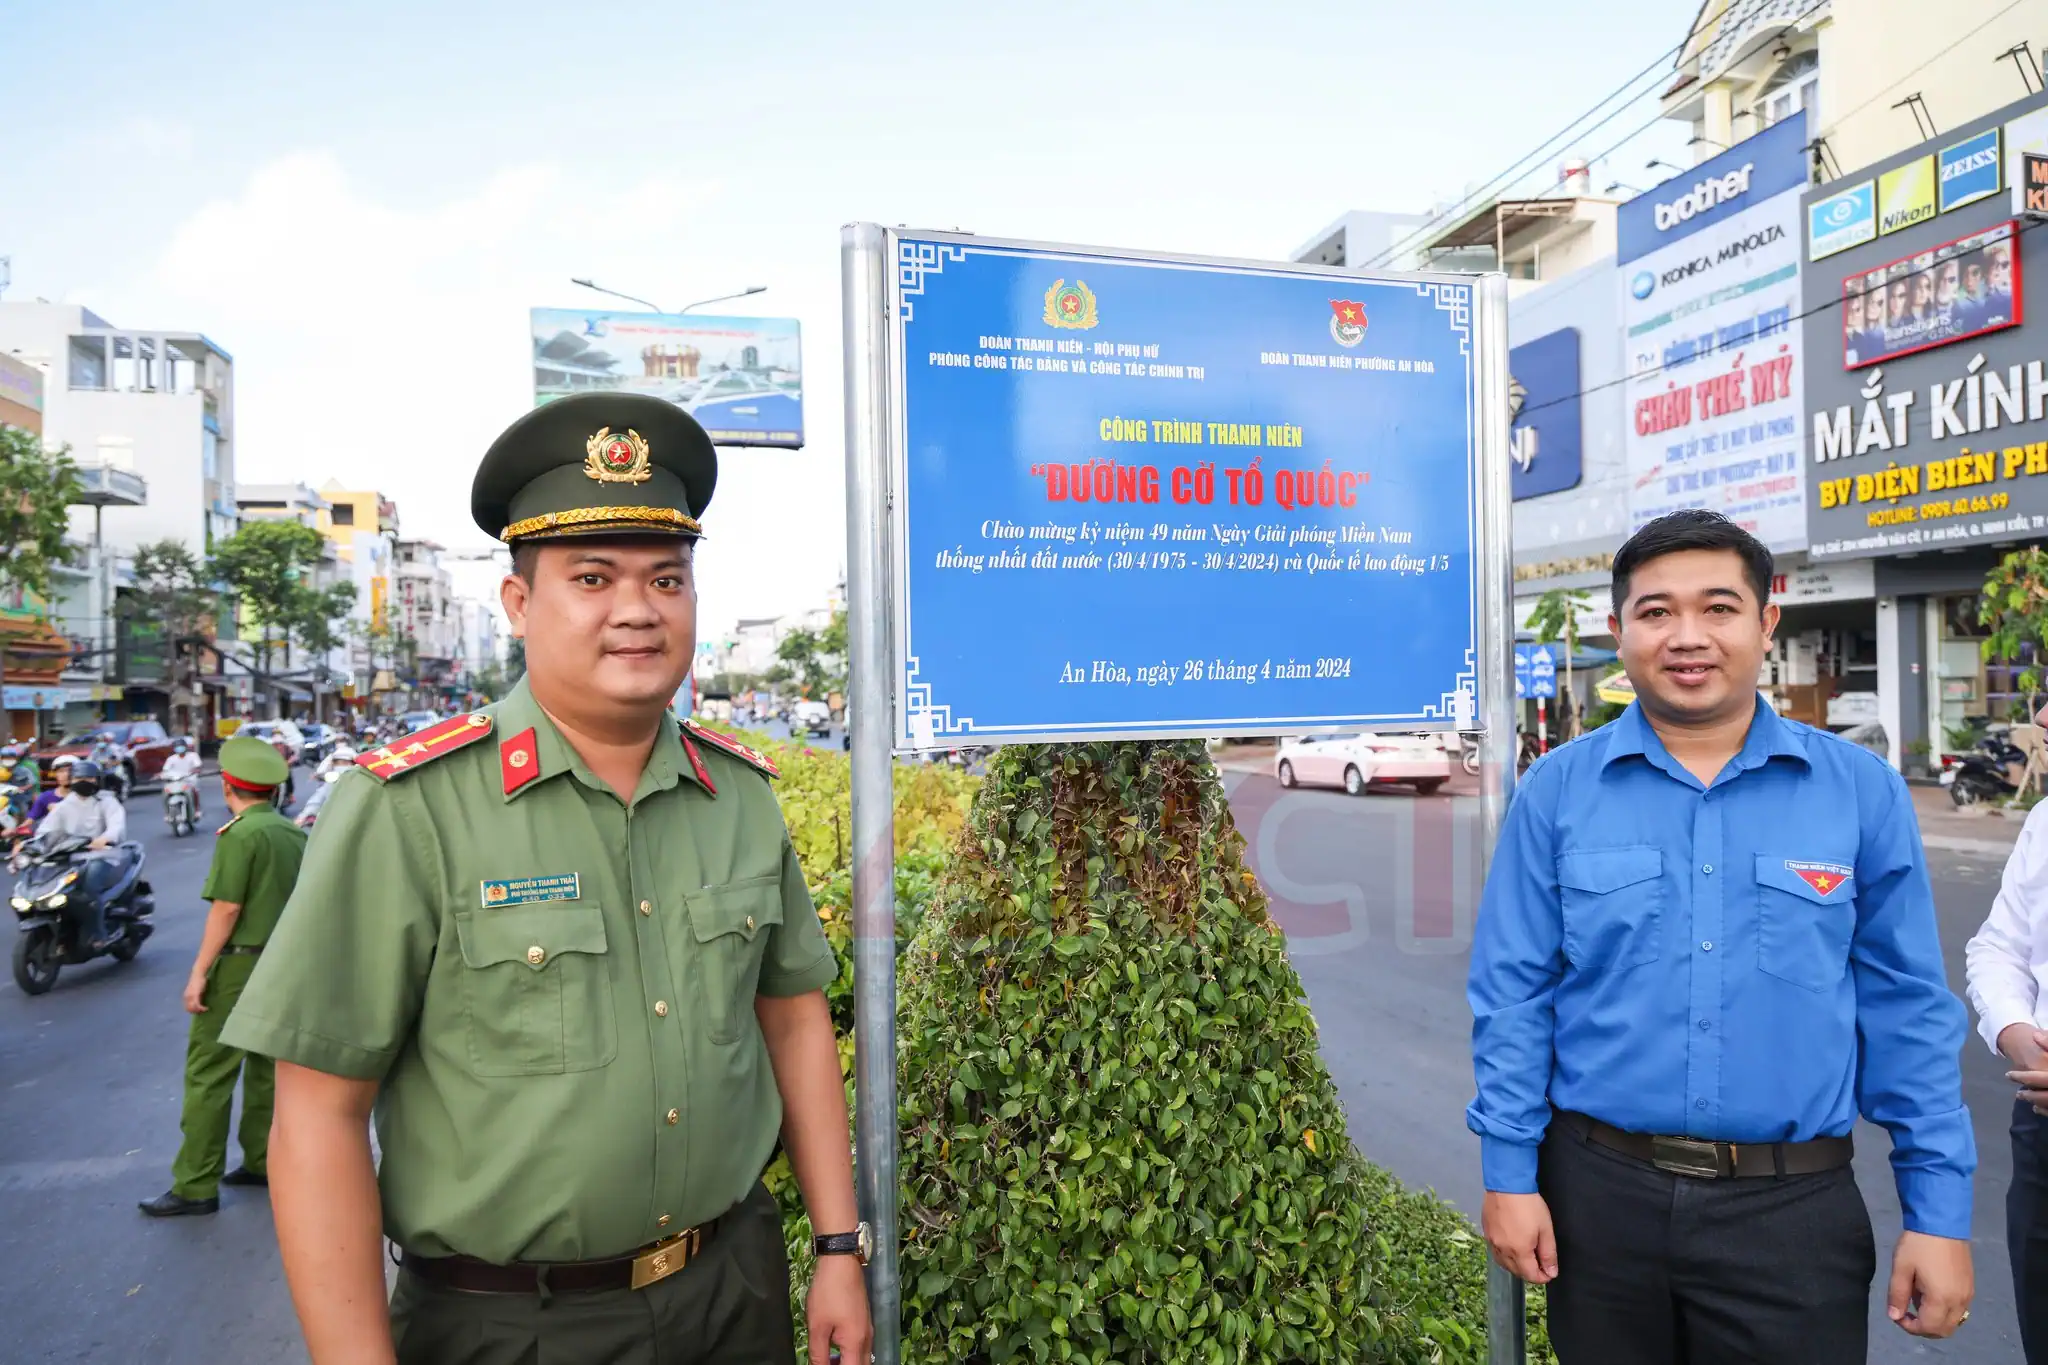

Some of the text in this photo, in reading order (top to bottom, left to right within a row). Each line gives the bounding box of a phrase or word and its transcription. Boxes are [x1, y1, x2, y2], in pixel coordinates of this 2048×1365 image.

[1941, 145, 1998, 182] ZEISS
[1654, 162, 1754, 231] brother
[1882, 203, 1932, 232] Nikon
[1661, 256, 1713, 288] KONICA
[1717, 224, 1786, 264] MINOLTA
[980, 334, 1012, 350] ĐOÀN
[1014, 337, 1054, 353] THANH
[1057, 338, 1083, 354] NIÊN
[1094, 340, 1114, 357] HỘI
[1117, 344, 1140, 360] PHỤ
[1143, 343, 1160, 359] NỮ
[1260, 350, 1435, 374] ĐOÀN THANH NIÊN PHƯỜNG AN HÒA
[929, 352, 970, 368] PHÒNG
[974, 354, 1007, 370] CÔNG
[1010, 355, 1033, 371] TÁC
[1071, 358, 1087, 374] VÀ
[1089, 360, 1121, 376] CÔNG
[1124, 362, 1146, 377] TÁC
[1149, 363, 1184, 379] CHÍNH
[1186, 366, 1205, 381] TRỊ
[1099, 415, 1303, 448] CÔNG TRÌNH THANH NIÊN
[1813, 367, 1915, 463] MẮT
[1509, 425, 1539, 474] NJ
[1170, 459, 1215, 506] CỜ
[1224, 455, 1264, 507] TỔ
[1819, 476, 1853, 509] BV
[1856, 461, 1920, 504] ĐIỆN
[1927, 447, 1996, 491] BIÊN
[981, 518, 1413, 548] Chào mừng kỷ niệm 49 năm Ngày Giải phóng Miền Nam
[935, 544, 985, 576] thống
[988, 544, 1028, 570] nhất
[1031, 544, 1059, 570] đất
[1062, 550, 1103, 570] nước
[1107, 551, 1187, 573] (30/4/1975
[1202, 552, 1280, 576] 30/4/2024)
[1283, 552, 1303, 571] và
[1306, 547, 1344, 576] Quốc
[1347, 548, 1362, 572] tế
[1364, 553, 1387, 572] lao
[1390, 554, 1427, 577] động
[1428, 555, 1451, 573] 1/5
[1058, 658, 1353, 687] An Hòa, ngày 26 tháng 4 năm 2024
[1788, 861, 1809, 870] THANH
[1826, 866, 1839, 875] VIỆT
